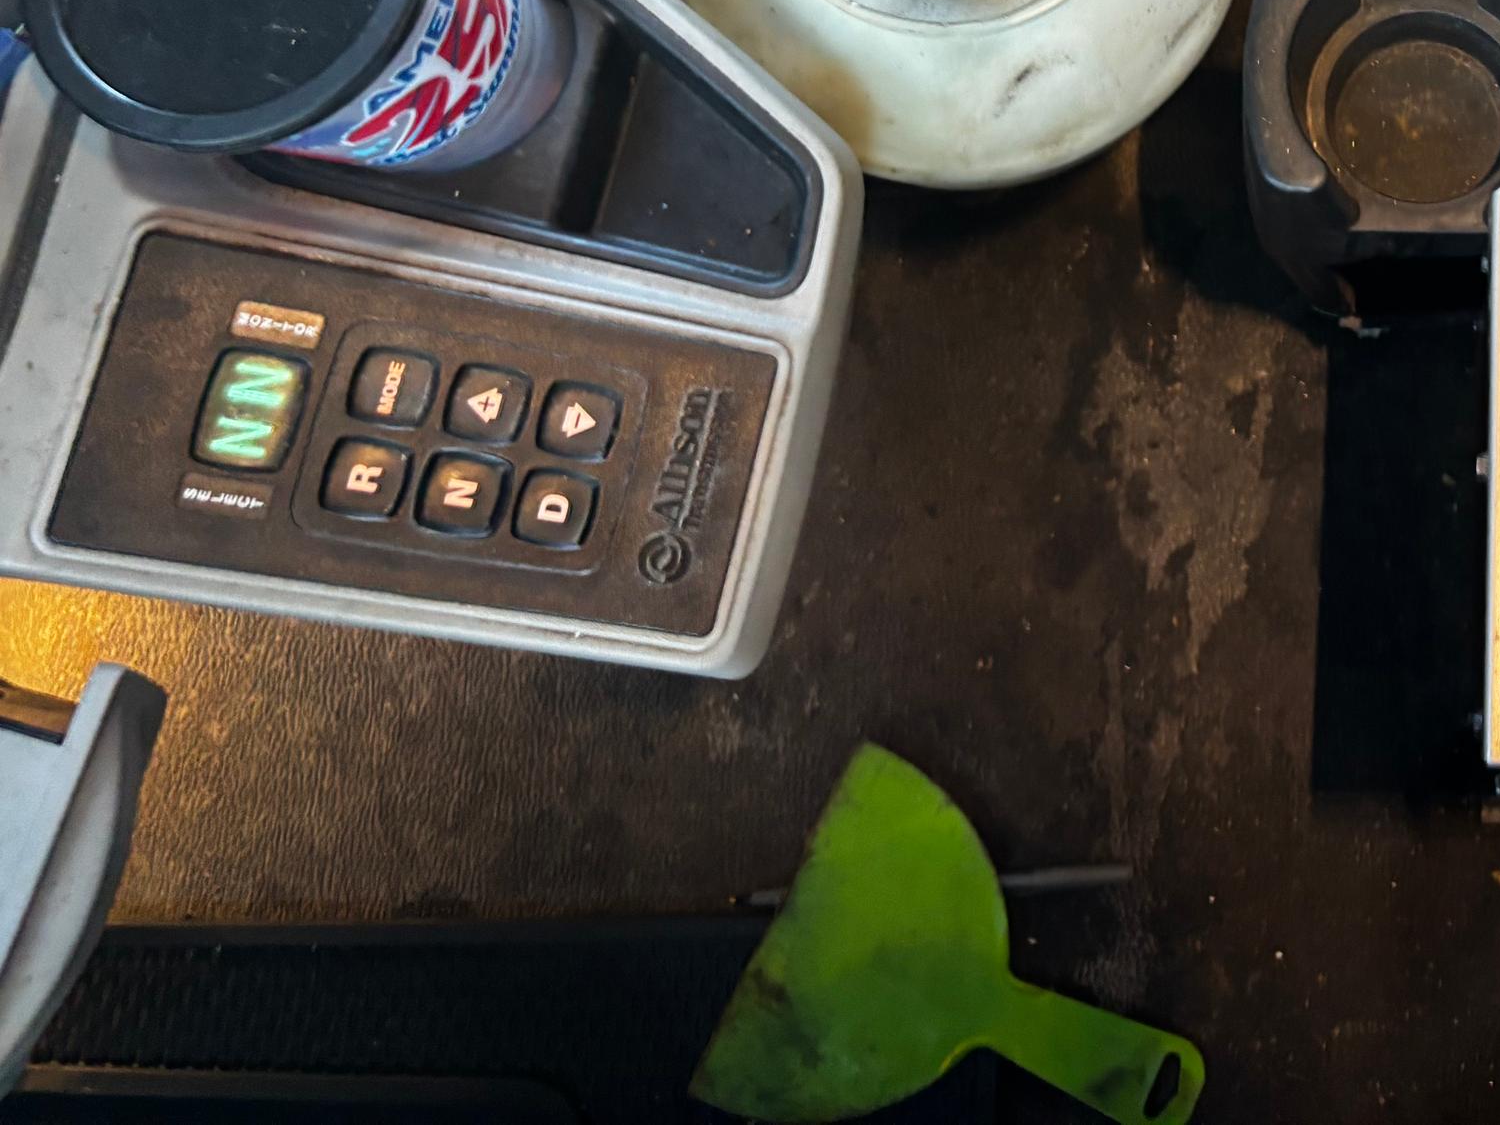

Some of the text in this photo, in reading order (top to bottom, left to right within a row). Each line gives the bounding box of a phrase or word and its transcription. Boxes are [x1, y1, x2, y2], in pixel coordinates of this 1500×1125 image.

[236, 312, 320, 338] MONITOR
[377, 360, 407, 416] MODE
[346, 463, 384, 494] R
[443, 478, 480, 509] N
[182, 487, 264, 509] SELECT
[536, 493, 570, 523] D
